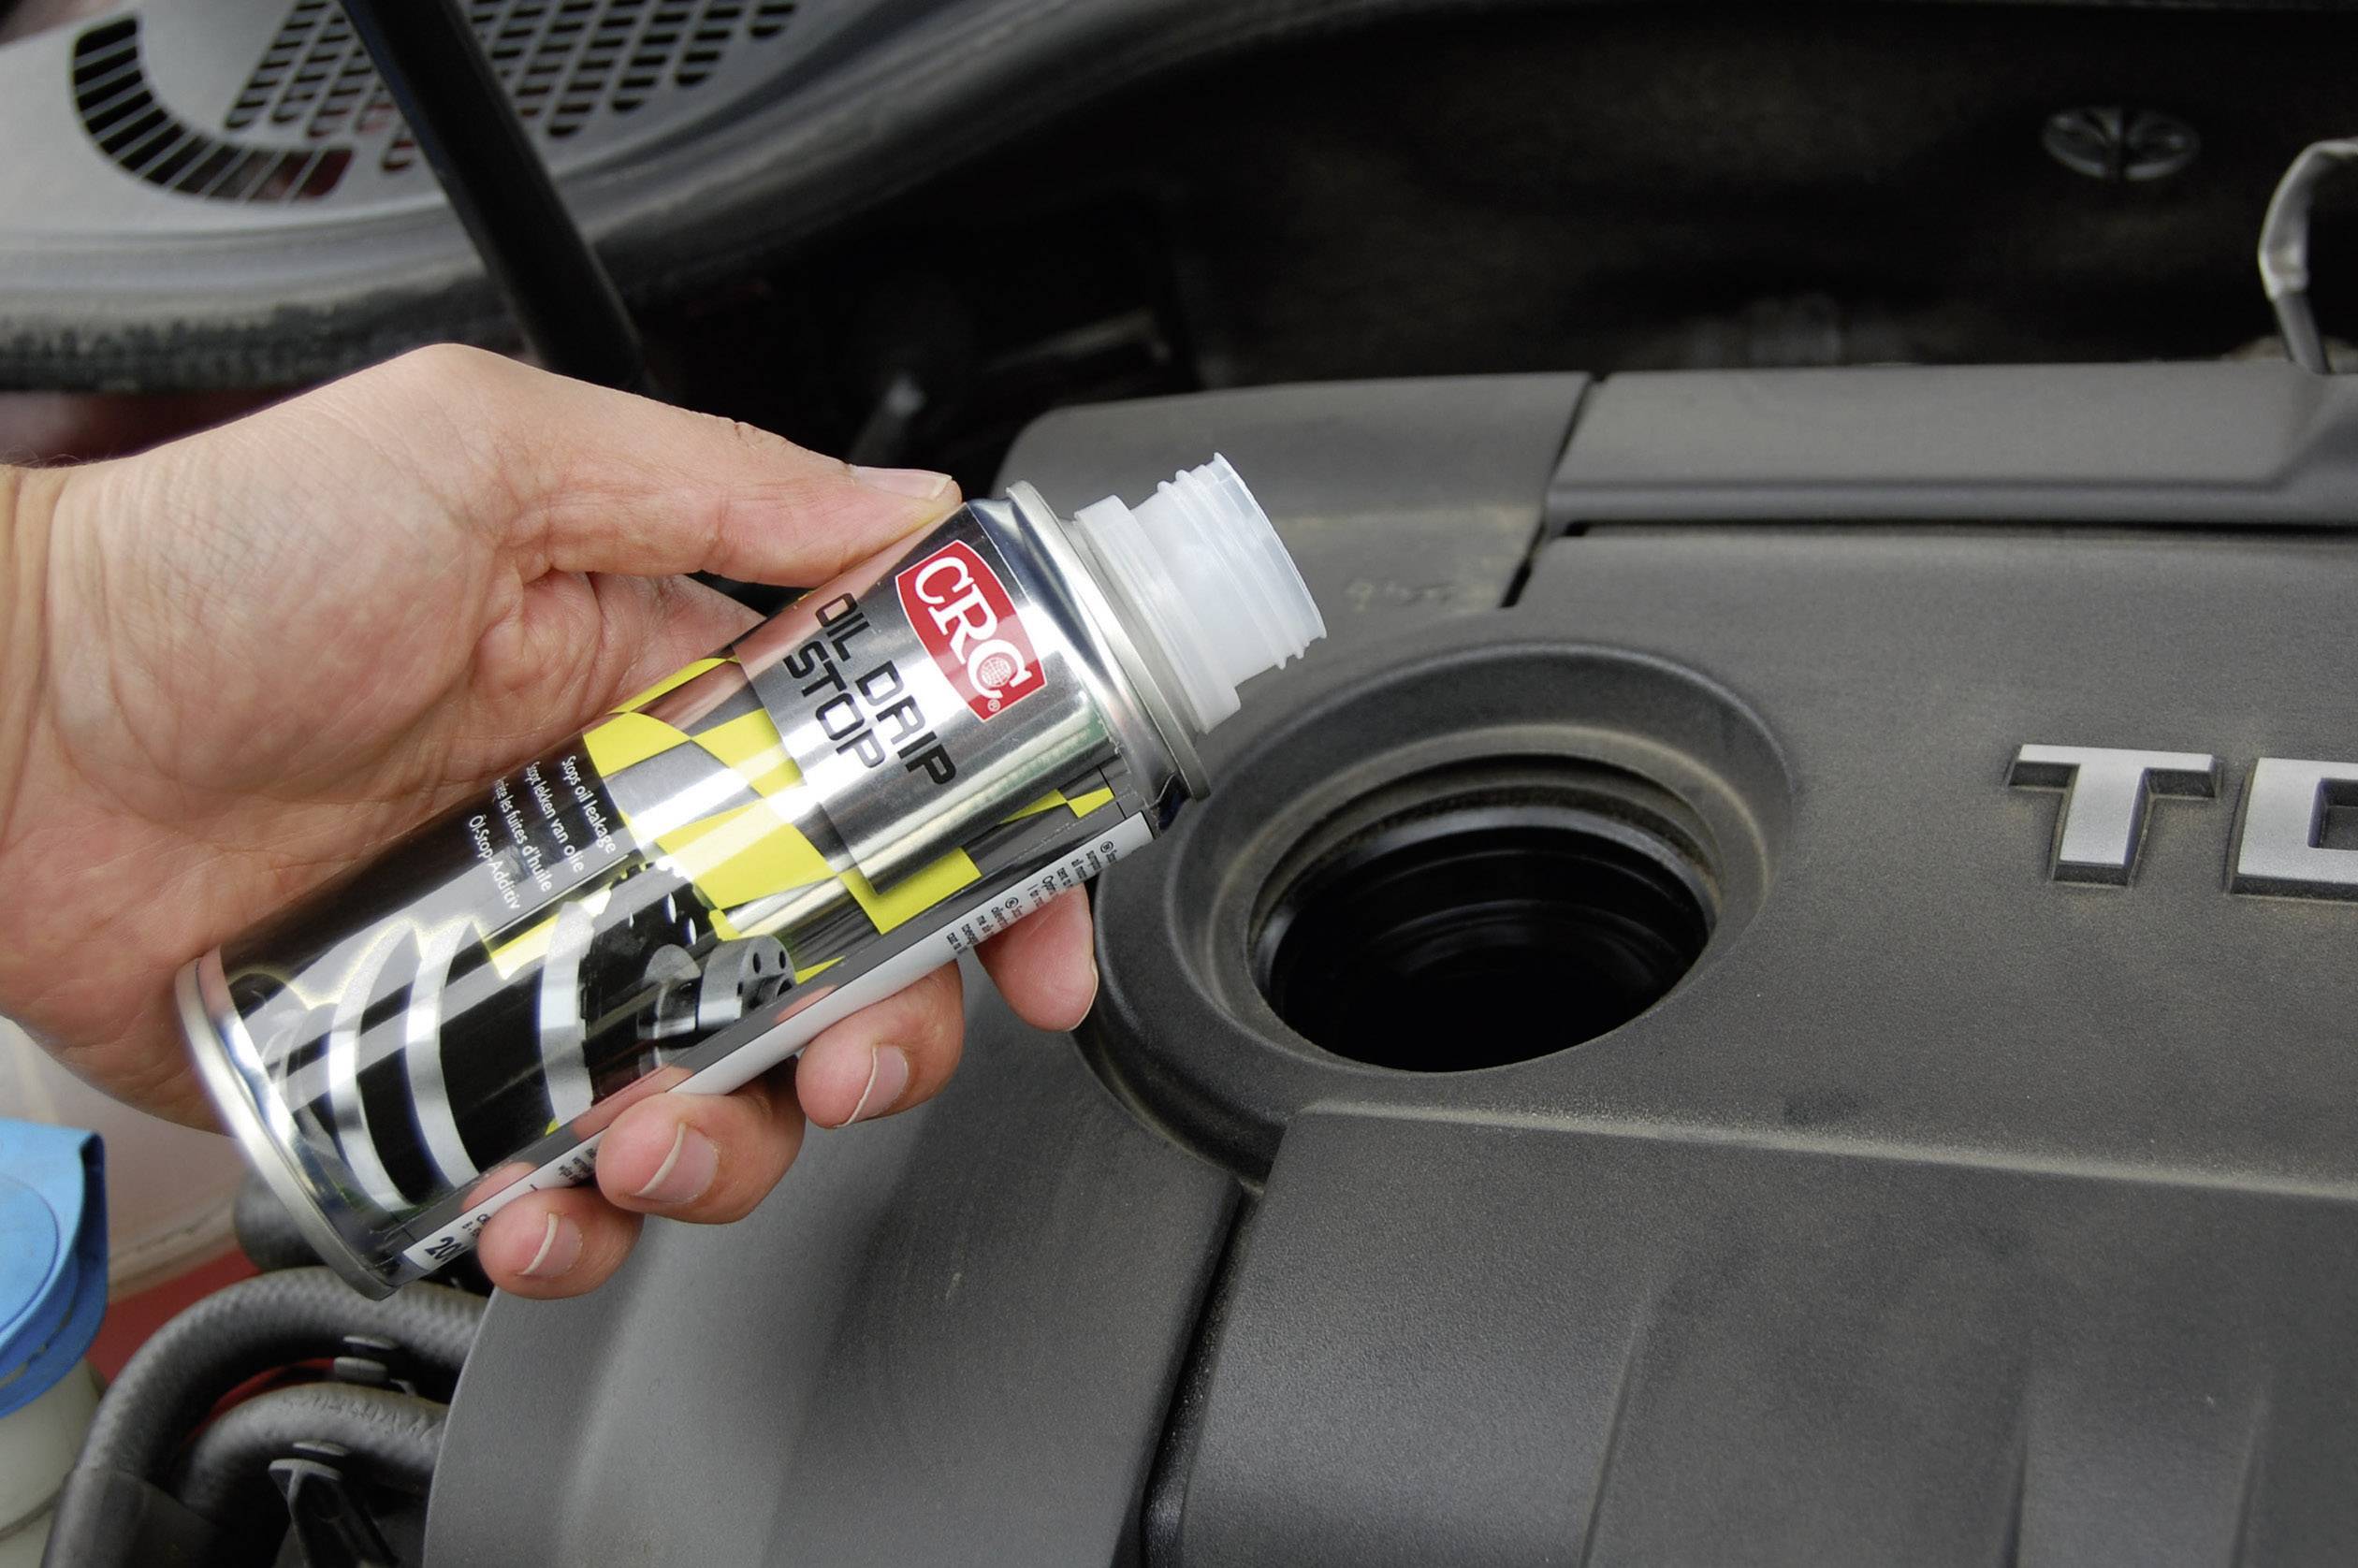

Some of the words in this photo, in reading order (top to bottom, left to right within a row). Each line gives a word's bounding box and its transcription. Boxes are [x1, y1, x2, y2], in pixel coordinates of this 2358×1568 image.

[914, 556, 1033, 700] CRC
[783, 641, 886, 768] STOP
[815, 592, 870, 661] OIL
[854, 660, 957, 785] DRIP
[525, 761, 542, 787] Stopt
[561, 755, 581, 791] Stops
[500, 794, 514, 813] les
[533, 780, 557, 819] lekken
[575, 784, 594, 803] oil
[506, 809, 528, 844] fuites
[550, 818, 569, 843] van
[583, 800, 616, 853] leakage
[469, 814, 521, 909] Öl-Stop-Additiv
[521, 843, 552, 892] d'huile
[563, 844, 585, 872] olie
[424, 1236, 465, 1263] 20
